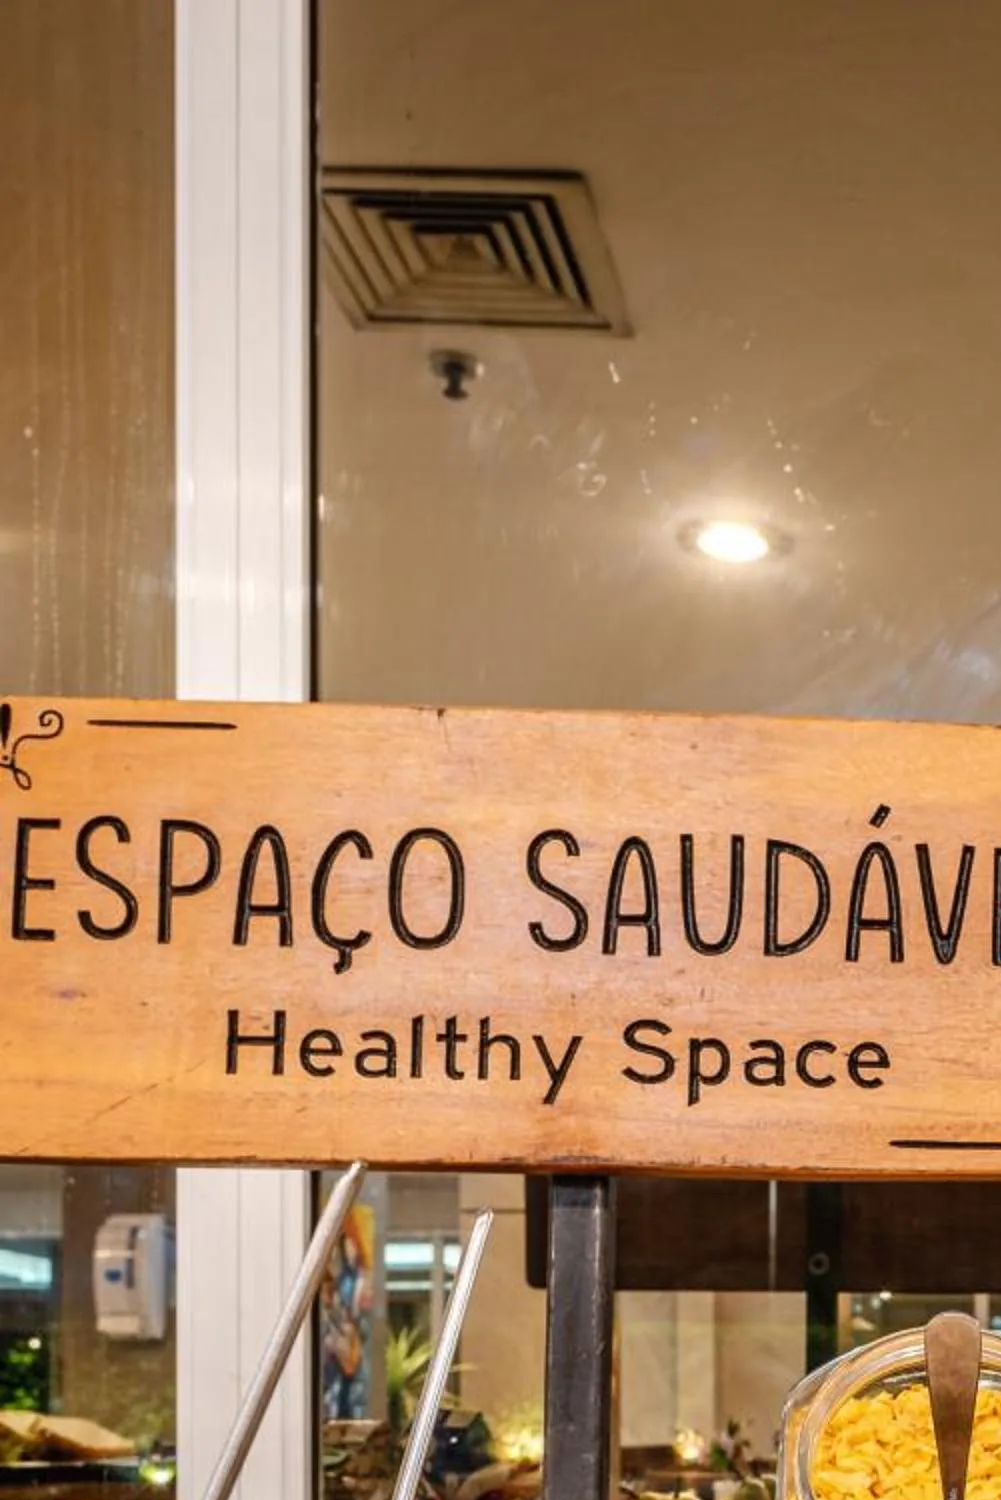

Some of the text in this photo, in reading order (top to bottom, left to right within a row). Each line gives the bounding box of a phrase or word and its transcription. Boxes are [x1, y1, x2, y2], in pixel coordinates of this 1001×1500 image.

[9, 814, 466, 975] ESPAÇO
[225, 1008, 891, 1106] Healthy Space
